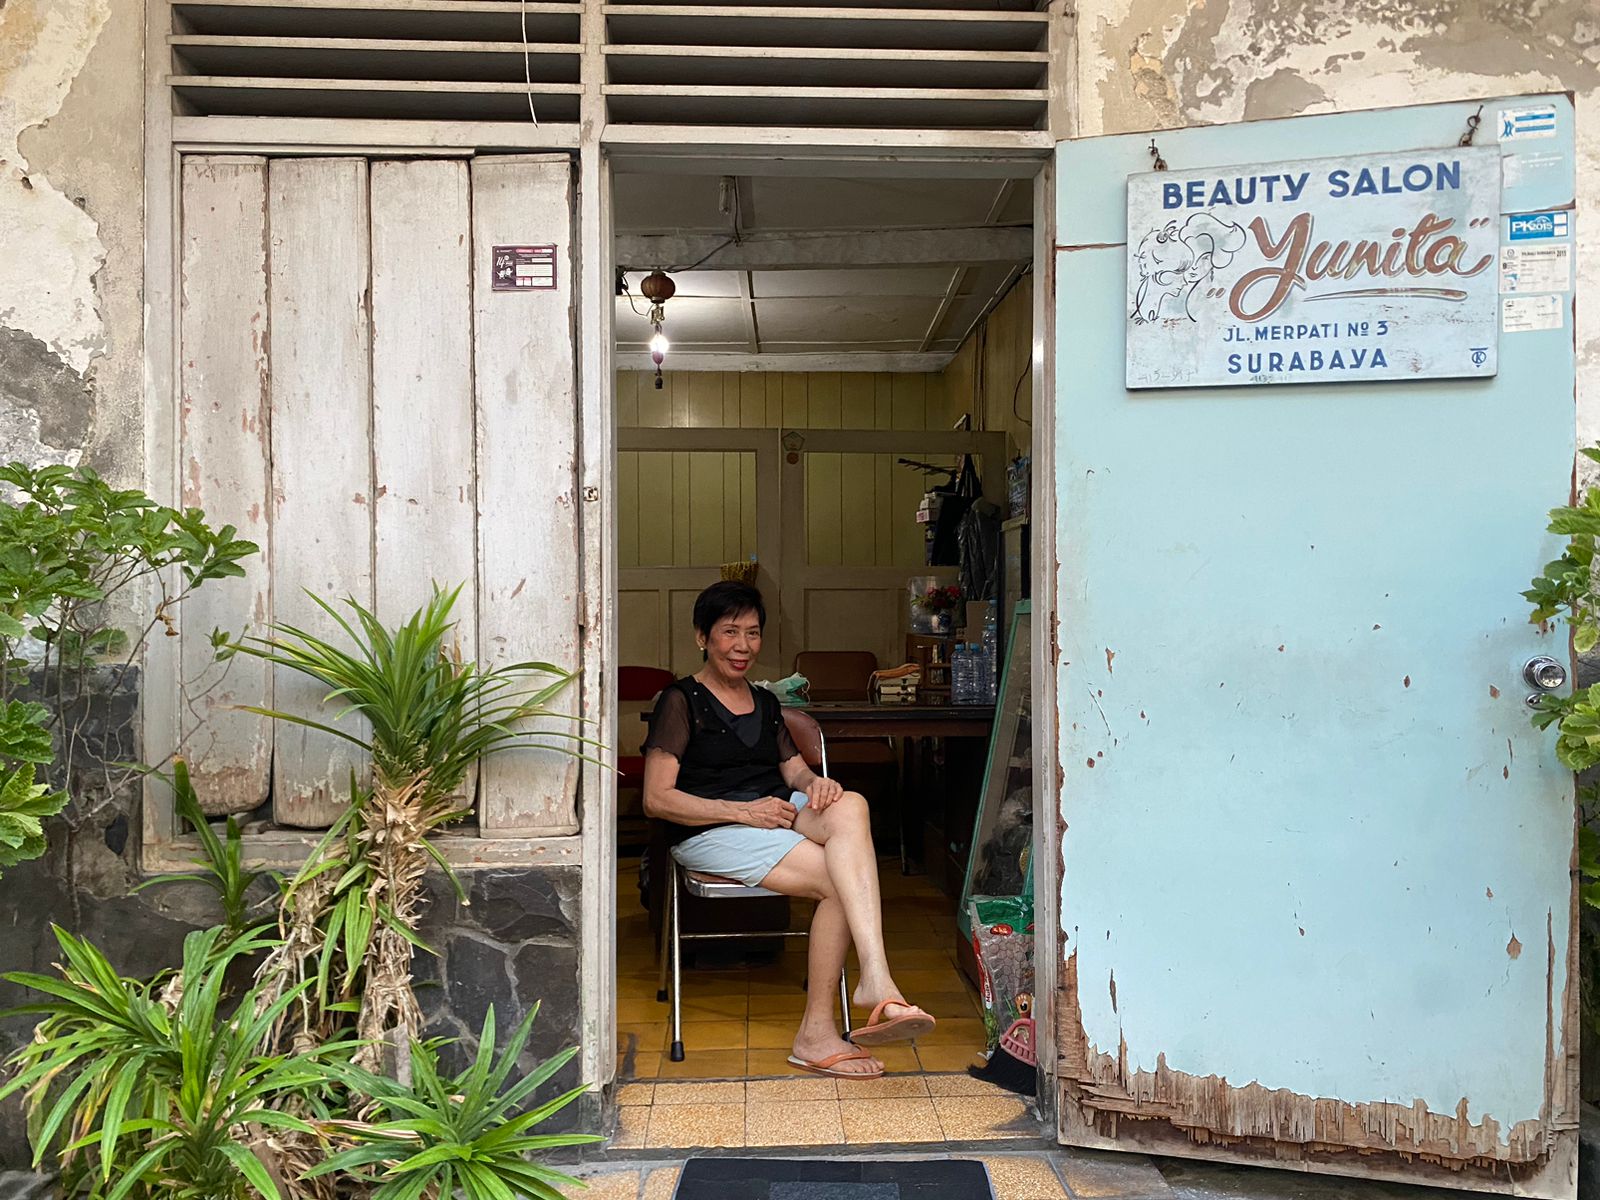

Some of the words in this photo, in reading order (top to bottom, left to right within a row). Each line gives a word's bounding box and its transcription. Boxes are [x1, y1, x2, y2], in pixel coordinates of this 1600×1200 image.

[1162, 173, 1311, 210] BEAUTY
[1327, 161, 1461, 199] SALON
[1254, 322, 1340, 342] MERPATI
[1376, 320, 1389, 336] 3
[1227, 348, 1388, 375] SURABAYA
